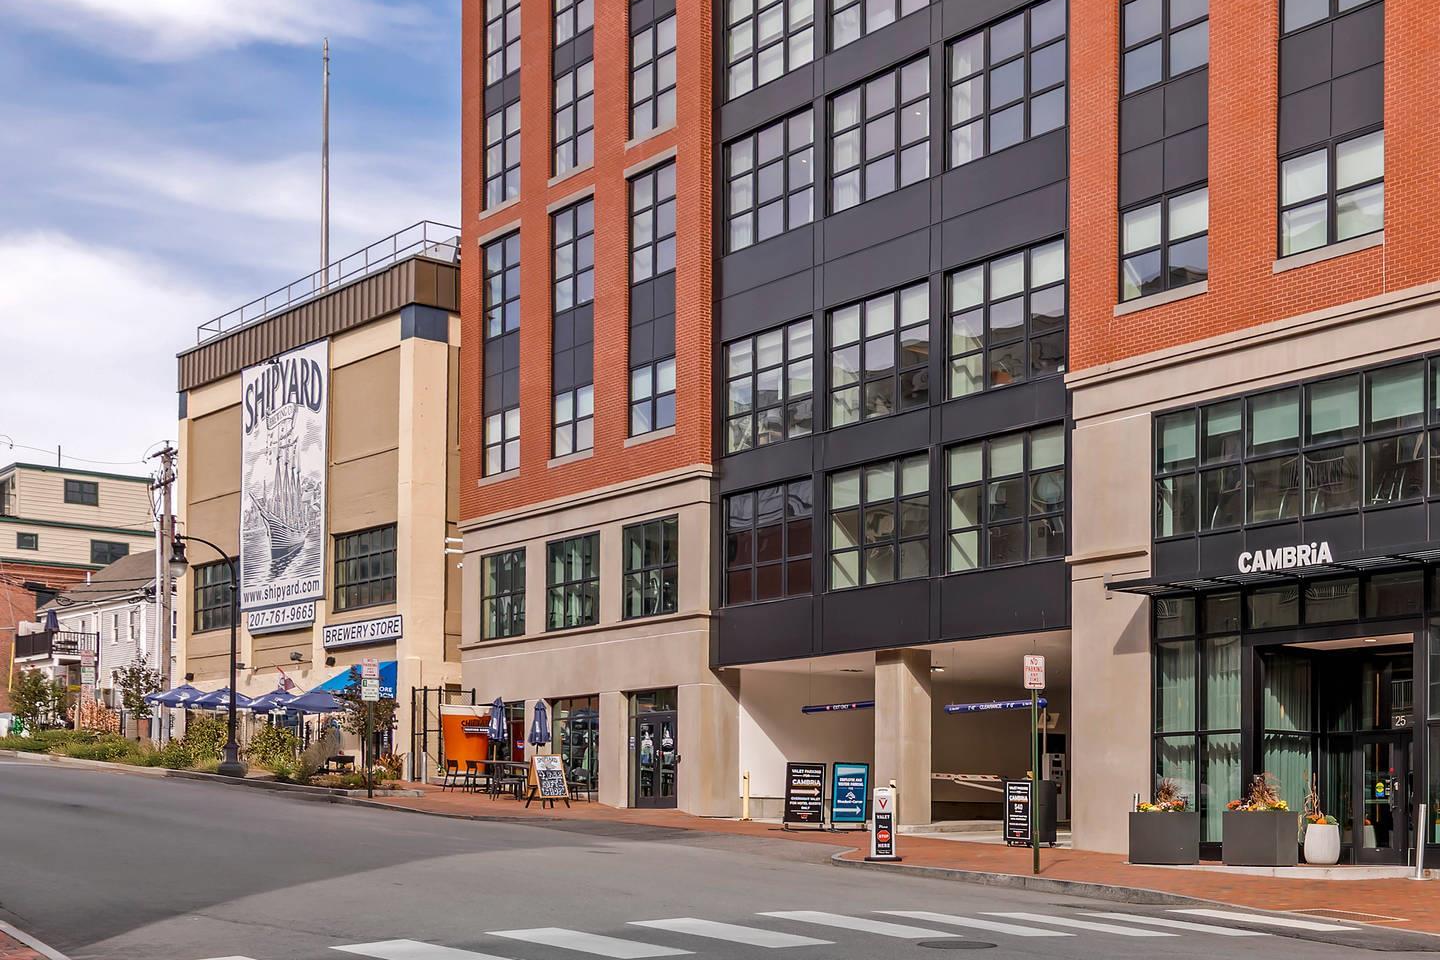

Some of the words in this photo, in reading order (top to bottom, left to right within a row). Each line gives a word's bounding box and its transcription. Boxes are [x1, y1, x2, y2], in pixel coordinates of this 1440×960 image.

[245, 357, 323, 435] SHIPYARD
[243, 579, 320, 603] www.shipyard.com
[249, 604, 314, 627] 207-761-9665
[325, 626, 369, 643] BREWERY
[369, 619, 400, 636] STORE
[1395, 715, 1406, 727] 25
